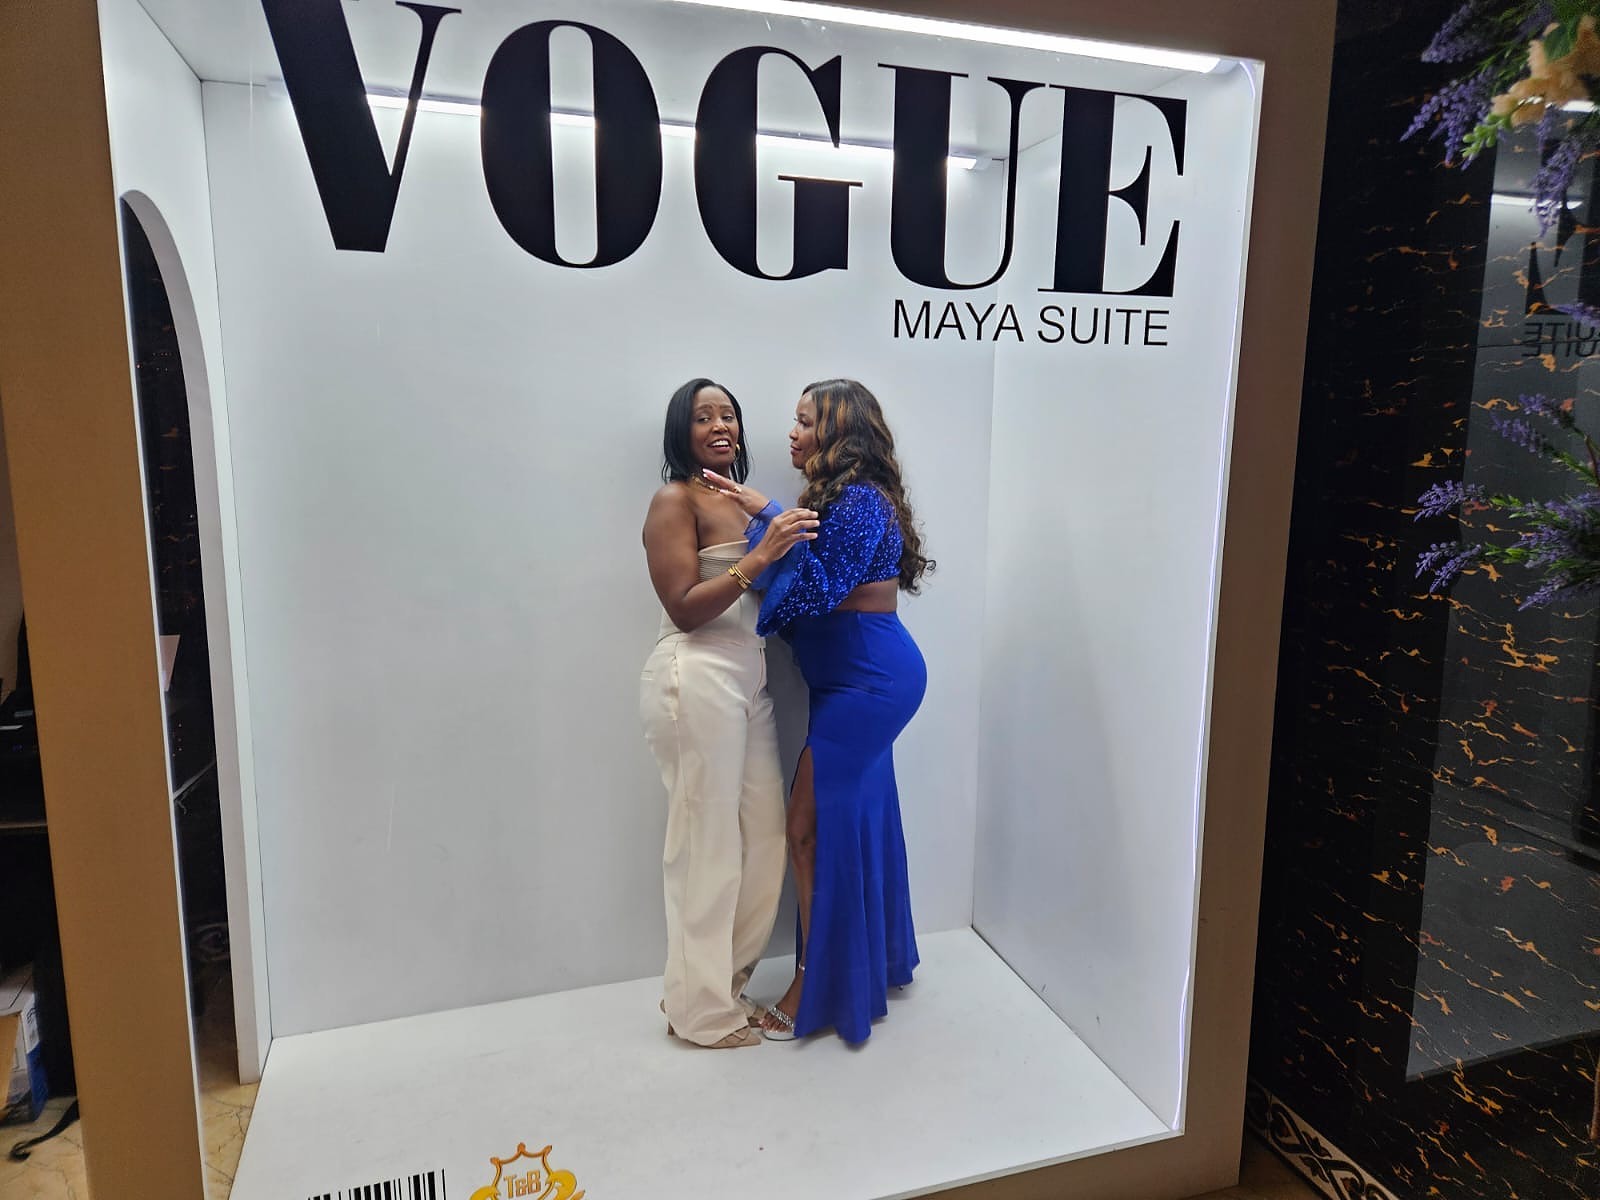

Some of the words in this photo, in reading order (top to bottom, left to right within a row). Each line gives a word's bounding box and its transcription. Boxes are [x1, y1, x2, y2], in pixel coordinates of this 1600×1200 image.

[262, 0, 1187, 298] VOGUE
[893, 299, 1025, 342] MAYA
[1037, 305, 1170, 346] SUITE
[503, 1170, 542, 1199] T&B
